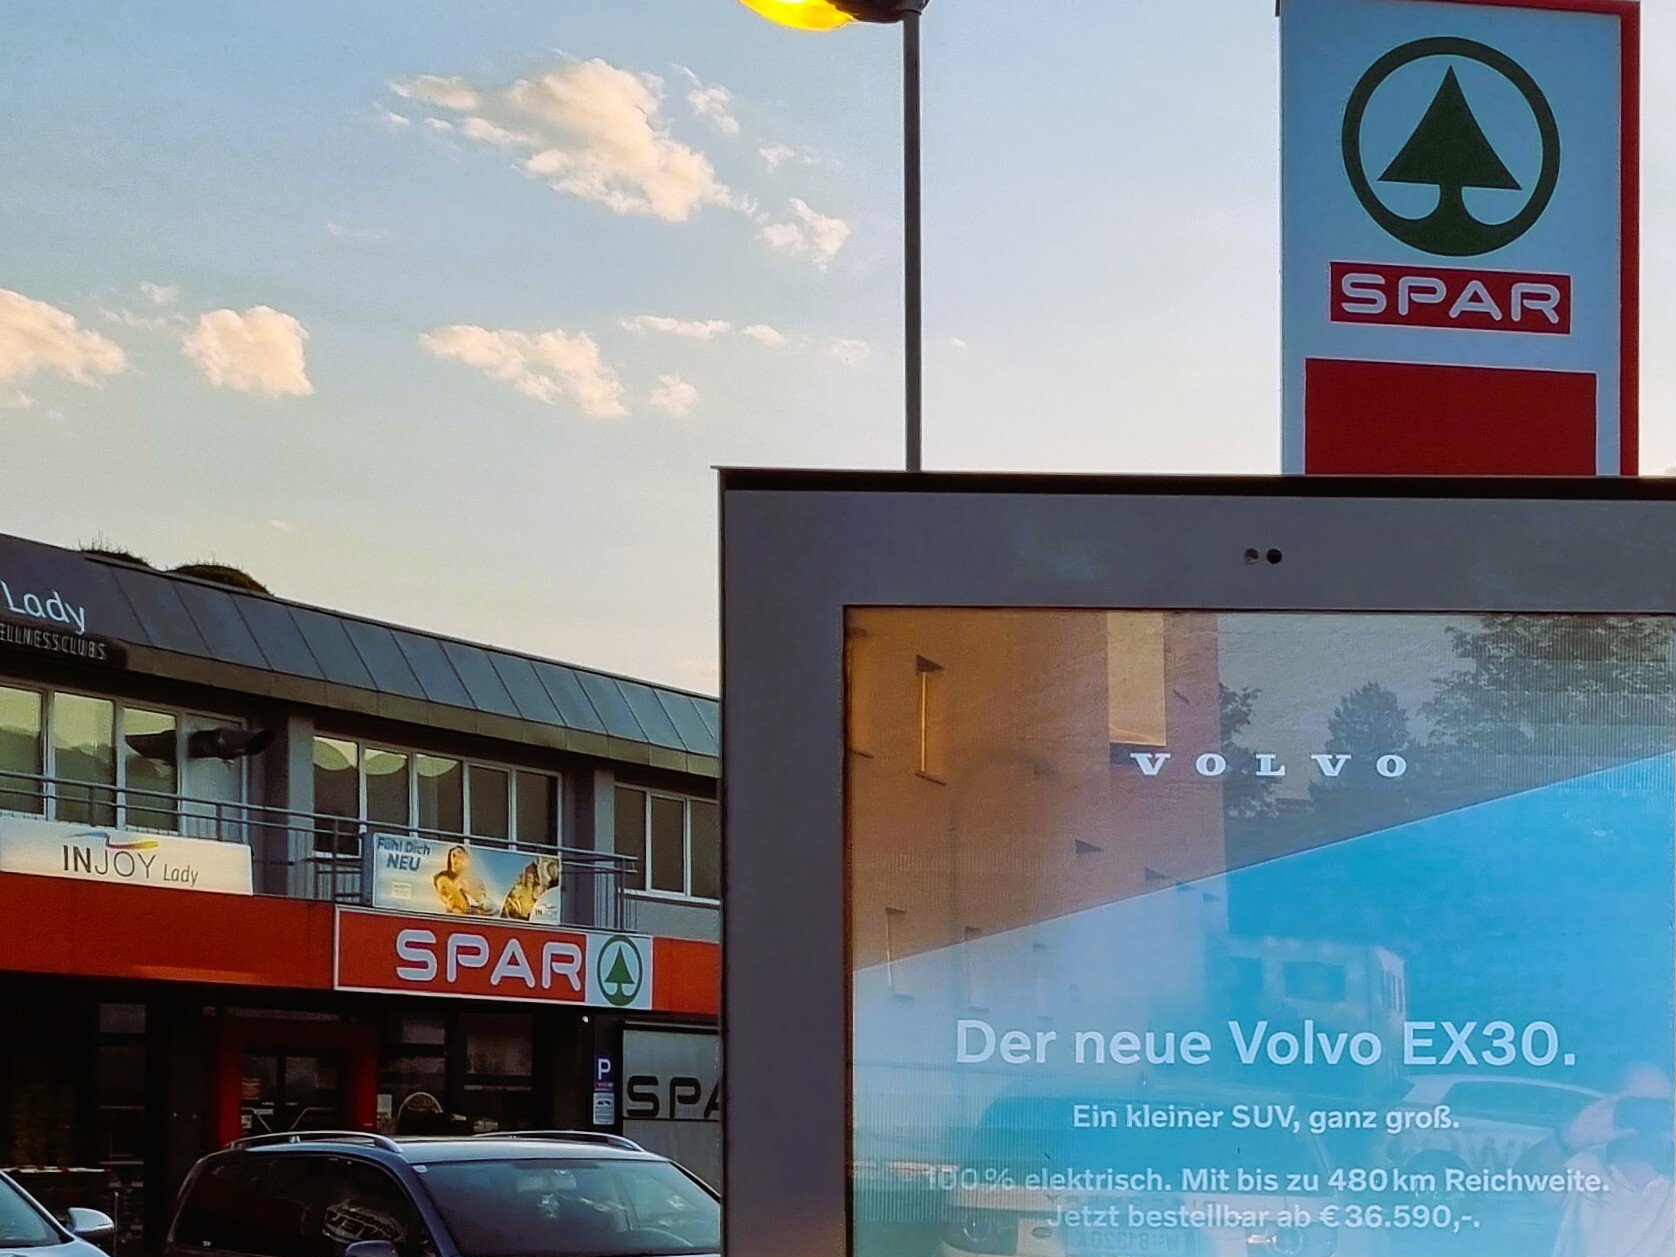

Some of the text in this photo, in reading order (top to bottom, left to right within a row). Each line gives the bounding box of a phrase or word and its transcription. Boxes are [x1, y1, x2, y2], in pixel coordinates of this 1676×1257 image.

[1341, 273, 1561, 323] SPAR
[0, 580, 86, 635] Lady
[1130, 753, 1407, 777] VOLVO
[63, 845, 198, 887] INJOY Lady
[387, 853, 421, 871] NEU
[396, 929, 582, 992] SPAR
[957, 1020, 1576, 1066] Der neue Volvo EX30.
[598, 1058, 611, 1080] P
[1074, 1104, 1459, 1134] Ein kleiner SUV, ganz groß.
[1025, 1167, 1171, 1191] elektrisch.
[1181, 1168, 1230, 1191] Mit
[1238, 1168, 1280, 1191] bis
[1287, 1174, 1319, 1191] zu
[1446, 1168, 1608, 1192] Reichweite.
[1048, 1205, 1120, 1228] Jetzt
[1128, 1204, 1266, 1228] bestellbar
[1277, 1204, 1311, 1228] ab
